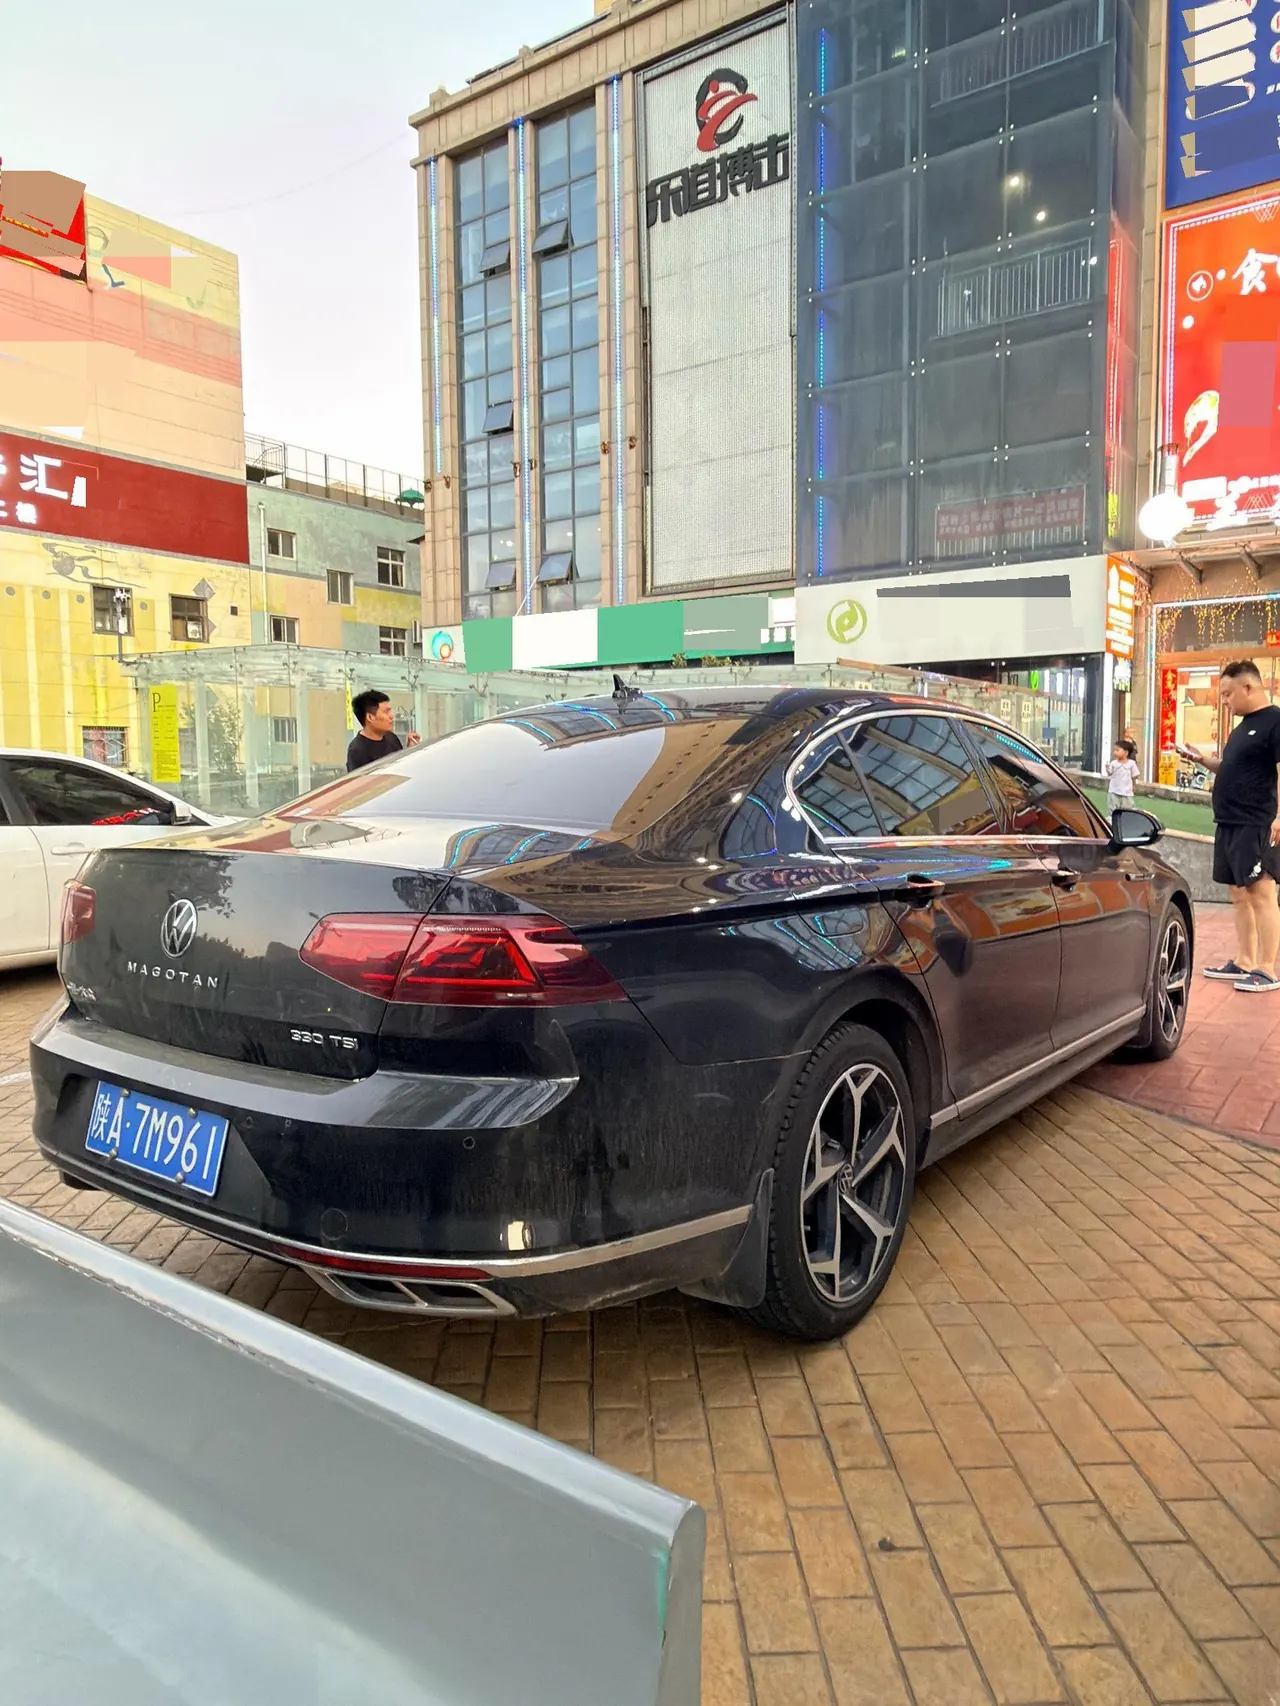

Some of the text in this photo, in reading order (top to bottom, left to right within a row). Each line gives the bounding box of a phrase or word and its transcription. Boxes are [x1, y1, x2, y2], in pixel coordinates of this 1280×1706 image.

[1231, 248, 1280, 295] 食
[127, 961, 218, 989] MAGOTAN
[290, 1029, 324, 1045] 330
